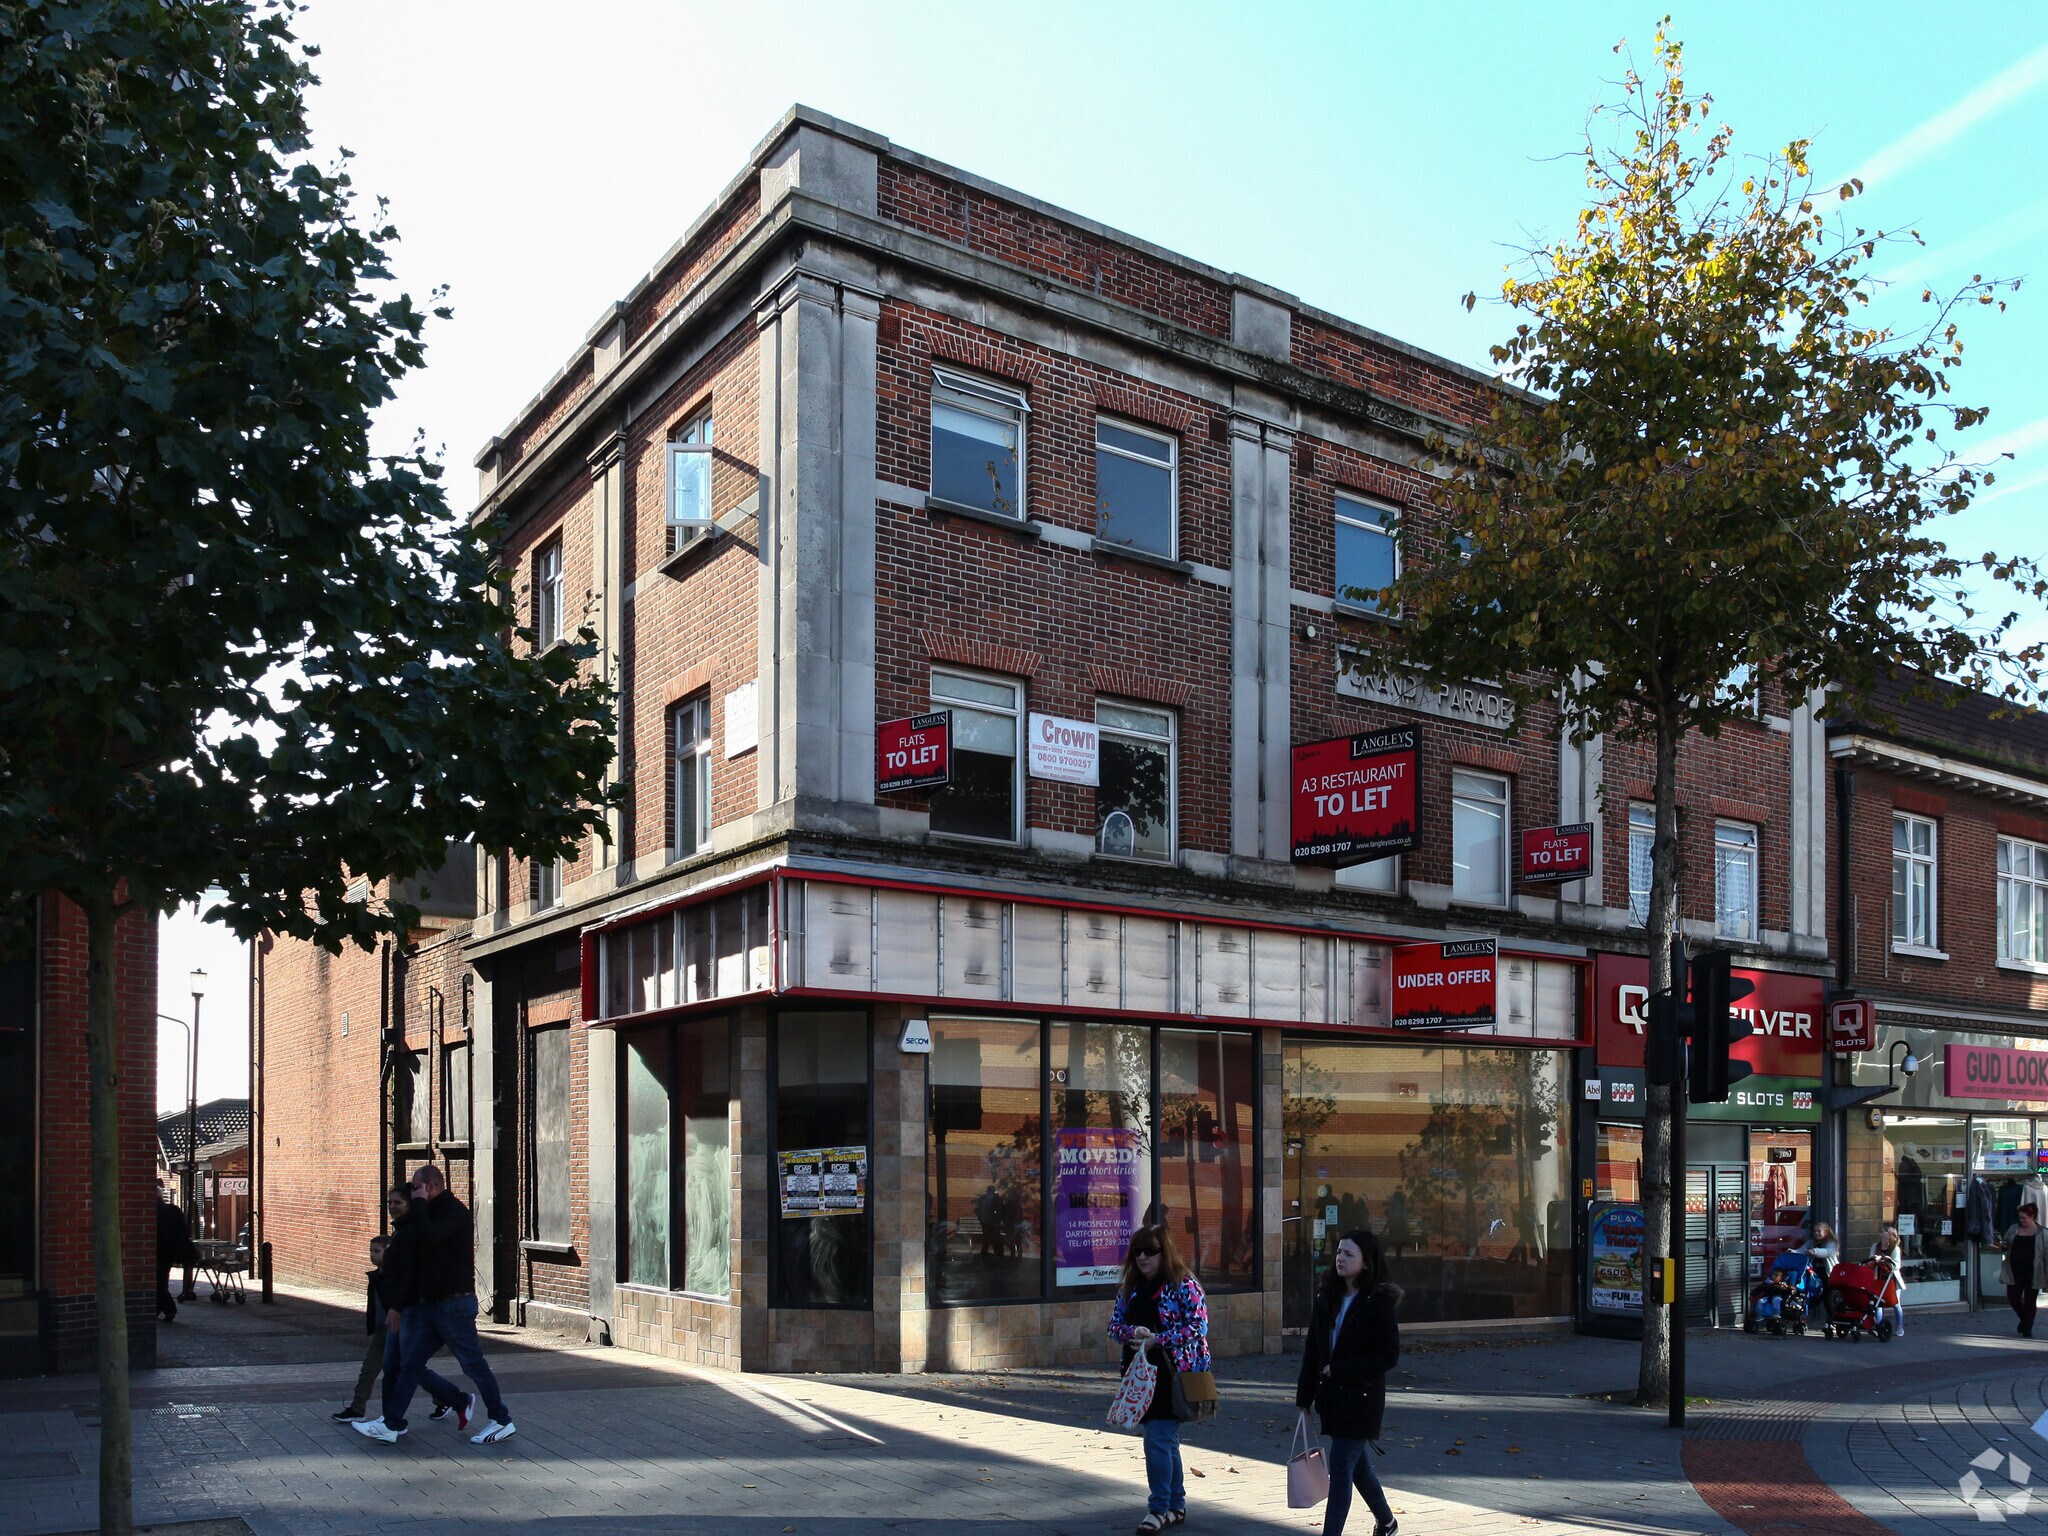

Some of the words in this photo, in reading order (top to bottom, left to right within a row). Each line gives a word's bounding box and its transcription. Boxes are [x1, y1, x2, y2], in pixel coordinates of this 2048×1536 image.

[1350, 664, 1417, 698] GRAND
[1438, 684, 1512, 721] PARADE
[912, 714, 946, 730] LANGLEYS
[899, 734, 925, 748] FLATS
[1042, 719, 1095, 750] Crown
[1352, 731, 1414, 757] LANGLEYS
[886, 751, 907, 769] TO
[911, 745, 939, 765] LET
[1037, 752, 1057, 763] 0800
[1059, 756, 1092, 768] 9700257
[1301, 777, 1317, 793] A3
[1321, 763, 1406, 790] RESTAURANT
[1314, 793, 1345, 818] TO
[1351, 785, 1392, 813] LET
[1556, 825, 1589, 836] LANGLEYS
[1295, 847, 1309, 857] 020
[1310, 844, 1330, 855] 8298
[1332, 842, 1352, 852] 1707
[1543, 839, 1568, 849] FLATS
[1530, 851, 1551, 864] TO
[1555, 847, 1582, 862] LET
[1443, 941, 1494, 957] LANGLEYS
[1398, 972, 1444, 989] UNDER
[1447, 969, 1491, 985] OFFER
[1395, 1018, 1407, 1026] 020
[1408, 1017, 1425, 1025] 8298
[1426, 1016, 1442, 1024] 1707
[1833, 1003, 1863, 1037] Q
[906, 1037, 929, 1045] SECOM
[1835, 1038, 1866, 1047] SLOTS
[1967, 1051, 2001, 1084] GUD
[1737, 1092, 1784, 1107] SLOTS
[828, 1152, 865, 1163] WOOLWICH
[1059, 1148, 1137, 1164] MOVED!
[1057, 1165, 1076, 1178] just
[1088, 1165, 1111, 1175] short
[1114, 1165, 1137, 1175] drive
[1078, 1220, 1112, 1228] PROSPECT
[1610, 1214, 1638, 1223] PLAY
[1120, 1228, 1132, 1236] 1DY
[1069, 1239, 1081, 1247] TEL:
[1083, 1239, 1103, 1247] 01322
[1105, 1238, 1117, 1246] 289
[1118, 1238, 1130, 1246] 353
[1092, 1268, 1108, 1277] Pizza
[1612, 1291, 1630, 1302] FUN
